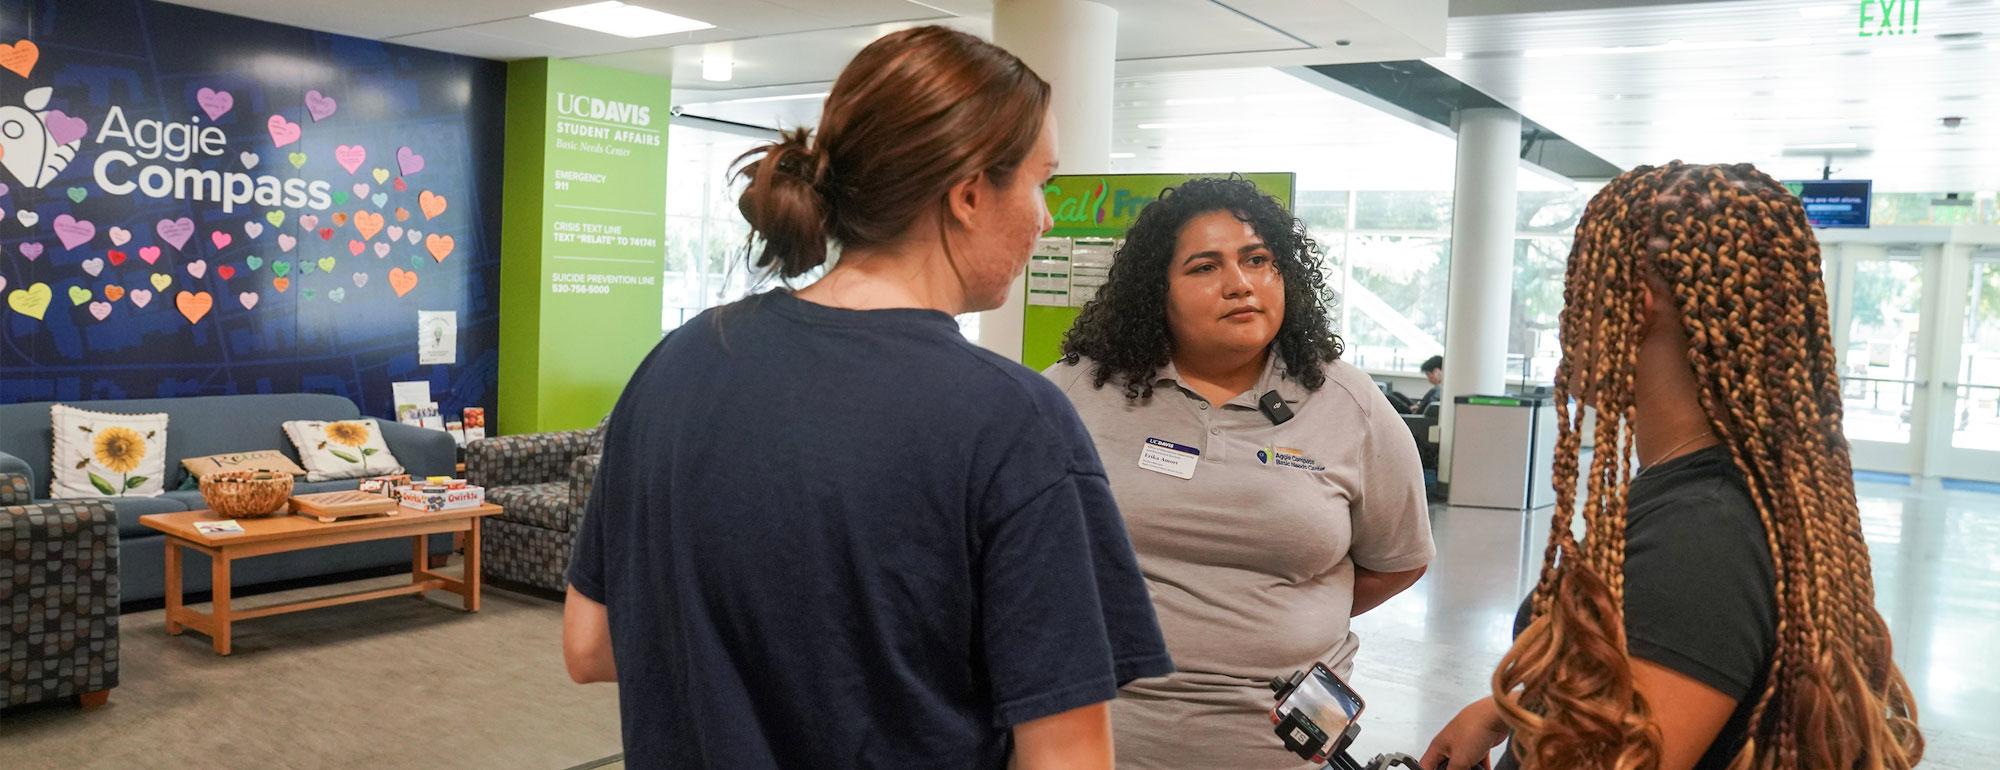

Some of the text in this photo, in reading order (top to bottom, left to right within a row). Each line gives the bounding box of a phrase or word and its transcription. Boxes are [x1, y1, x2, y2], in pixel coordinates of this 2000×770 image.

[1859, 0, 1919, 37] EXIT
[95, 105, 227, 162] Aggie
[556, 122, 661, 146] STUDENT AFFAIRS
[556, 139, 631, 156] Basic Needs Center
[93, 150, 332, 213] Compass
[555, 170, 607, 183] EMERGENCY
[554, 181, 569, 190] 911
[1113, 188, 1154, 217] Fr
[554, 222, 622, 234] CRISIS TEXT LINE
[554, 233, 575, 242] TEXT
[617, 237, 628, 246] TO
[552, 273, 655, 285] SUICIDE PREVENTION LINE
[1276, 452, 1315, 465] Aggie Compass
[1276, 459, 1290, 467] Basic
[448, 492, 478, 503] Qwirkle
